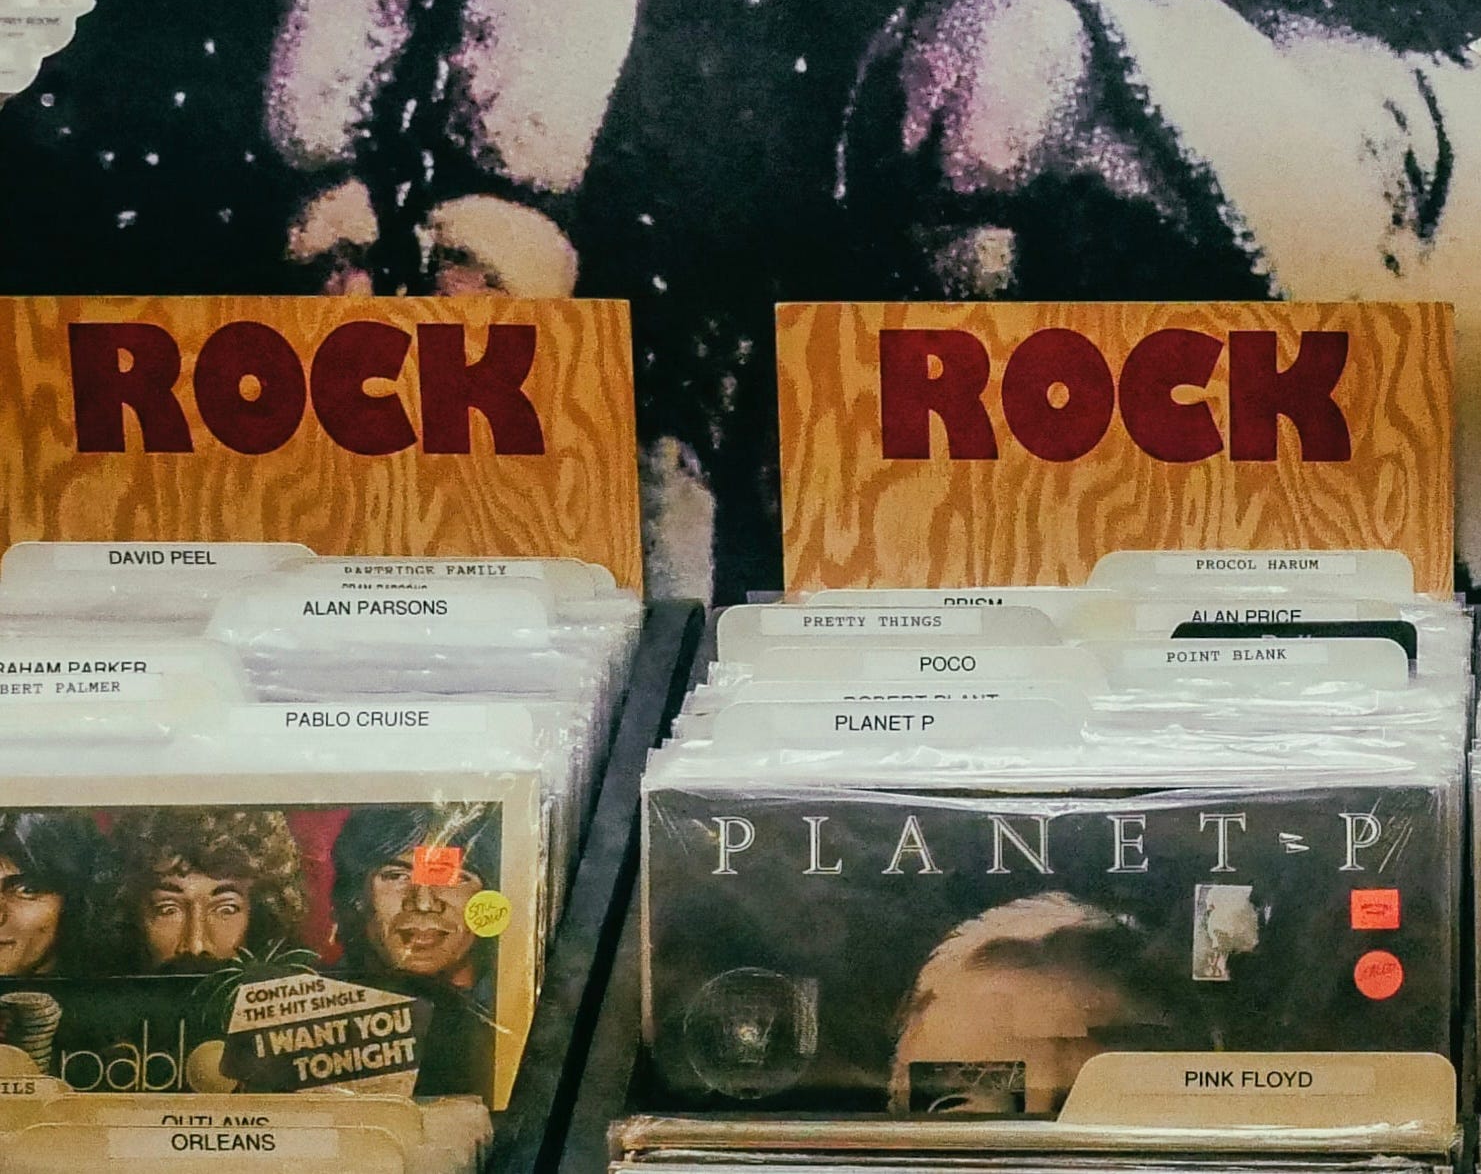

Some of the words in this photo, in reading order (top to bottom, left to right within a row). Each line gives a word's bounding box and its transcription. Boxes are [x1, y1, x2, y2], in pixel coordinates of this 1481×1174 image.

[68, 321, 545, 455] ROCK
[879, 328, 1352, 463] ROCK
[109, 551, 165, 565] DAVID
[171, 551, 216, 565] PEEL
[1196, 560, 1257, 570] PROCOL
[1268, 560, 1319, 570] HARUM
[446, 566, 507, 575] FAMILY
[303, 601, 351, 615] ALAN
[357, 600, 448, 615] PARSONS
[1192, 610, 1239, 622] ALAN
[1245, 609, 1302, 622] PRICE
[803, 616, 866, 627] PRETTY
[878, 616, 942, 627] THINGS
[1166, 651, 1221, 663] POINT
[1232, 648, 1288, 661] BLANK
[68, 662, 147, 673] PARKER
[920, 656, 976, 672] POCO
[55, 681, 121, 694] PALMER
[286, 712, 351, 727] PABLO
[356, 711, 430, 726] CRUISE
[835, 715, 915, 731] PLANET
[922, 715, 935, 730] P
[711, 812, 1247, 876] PLANET
[1338, 812, 1382, 871] P
[245, 979, 325, 1003] CONTAINS
[244, 1005, 276, 1021] THE
[280, 999, 306, 1015] HIT
[311, 989, 367, 1011] SINGLE
[255, 1033, 266, 1058] I
[269, 1018, 348, 1055] WANT
[354, 1007, 412, 1040] YOU
[293, 1036, 417, 1082] TONIGHT
[1185, 1071, 1234, 1087] PINK
[1241, 1071, 1313, 1088] FLOYD
[171, 1133, 275, 1151] ORLEANS
